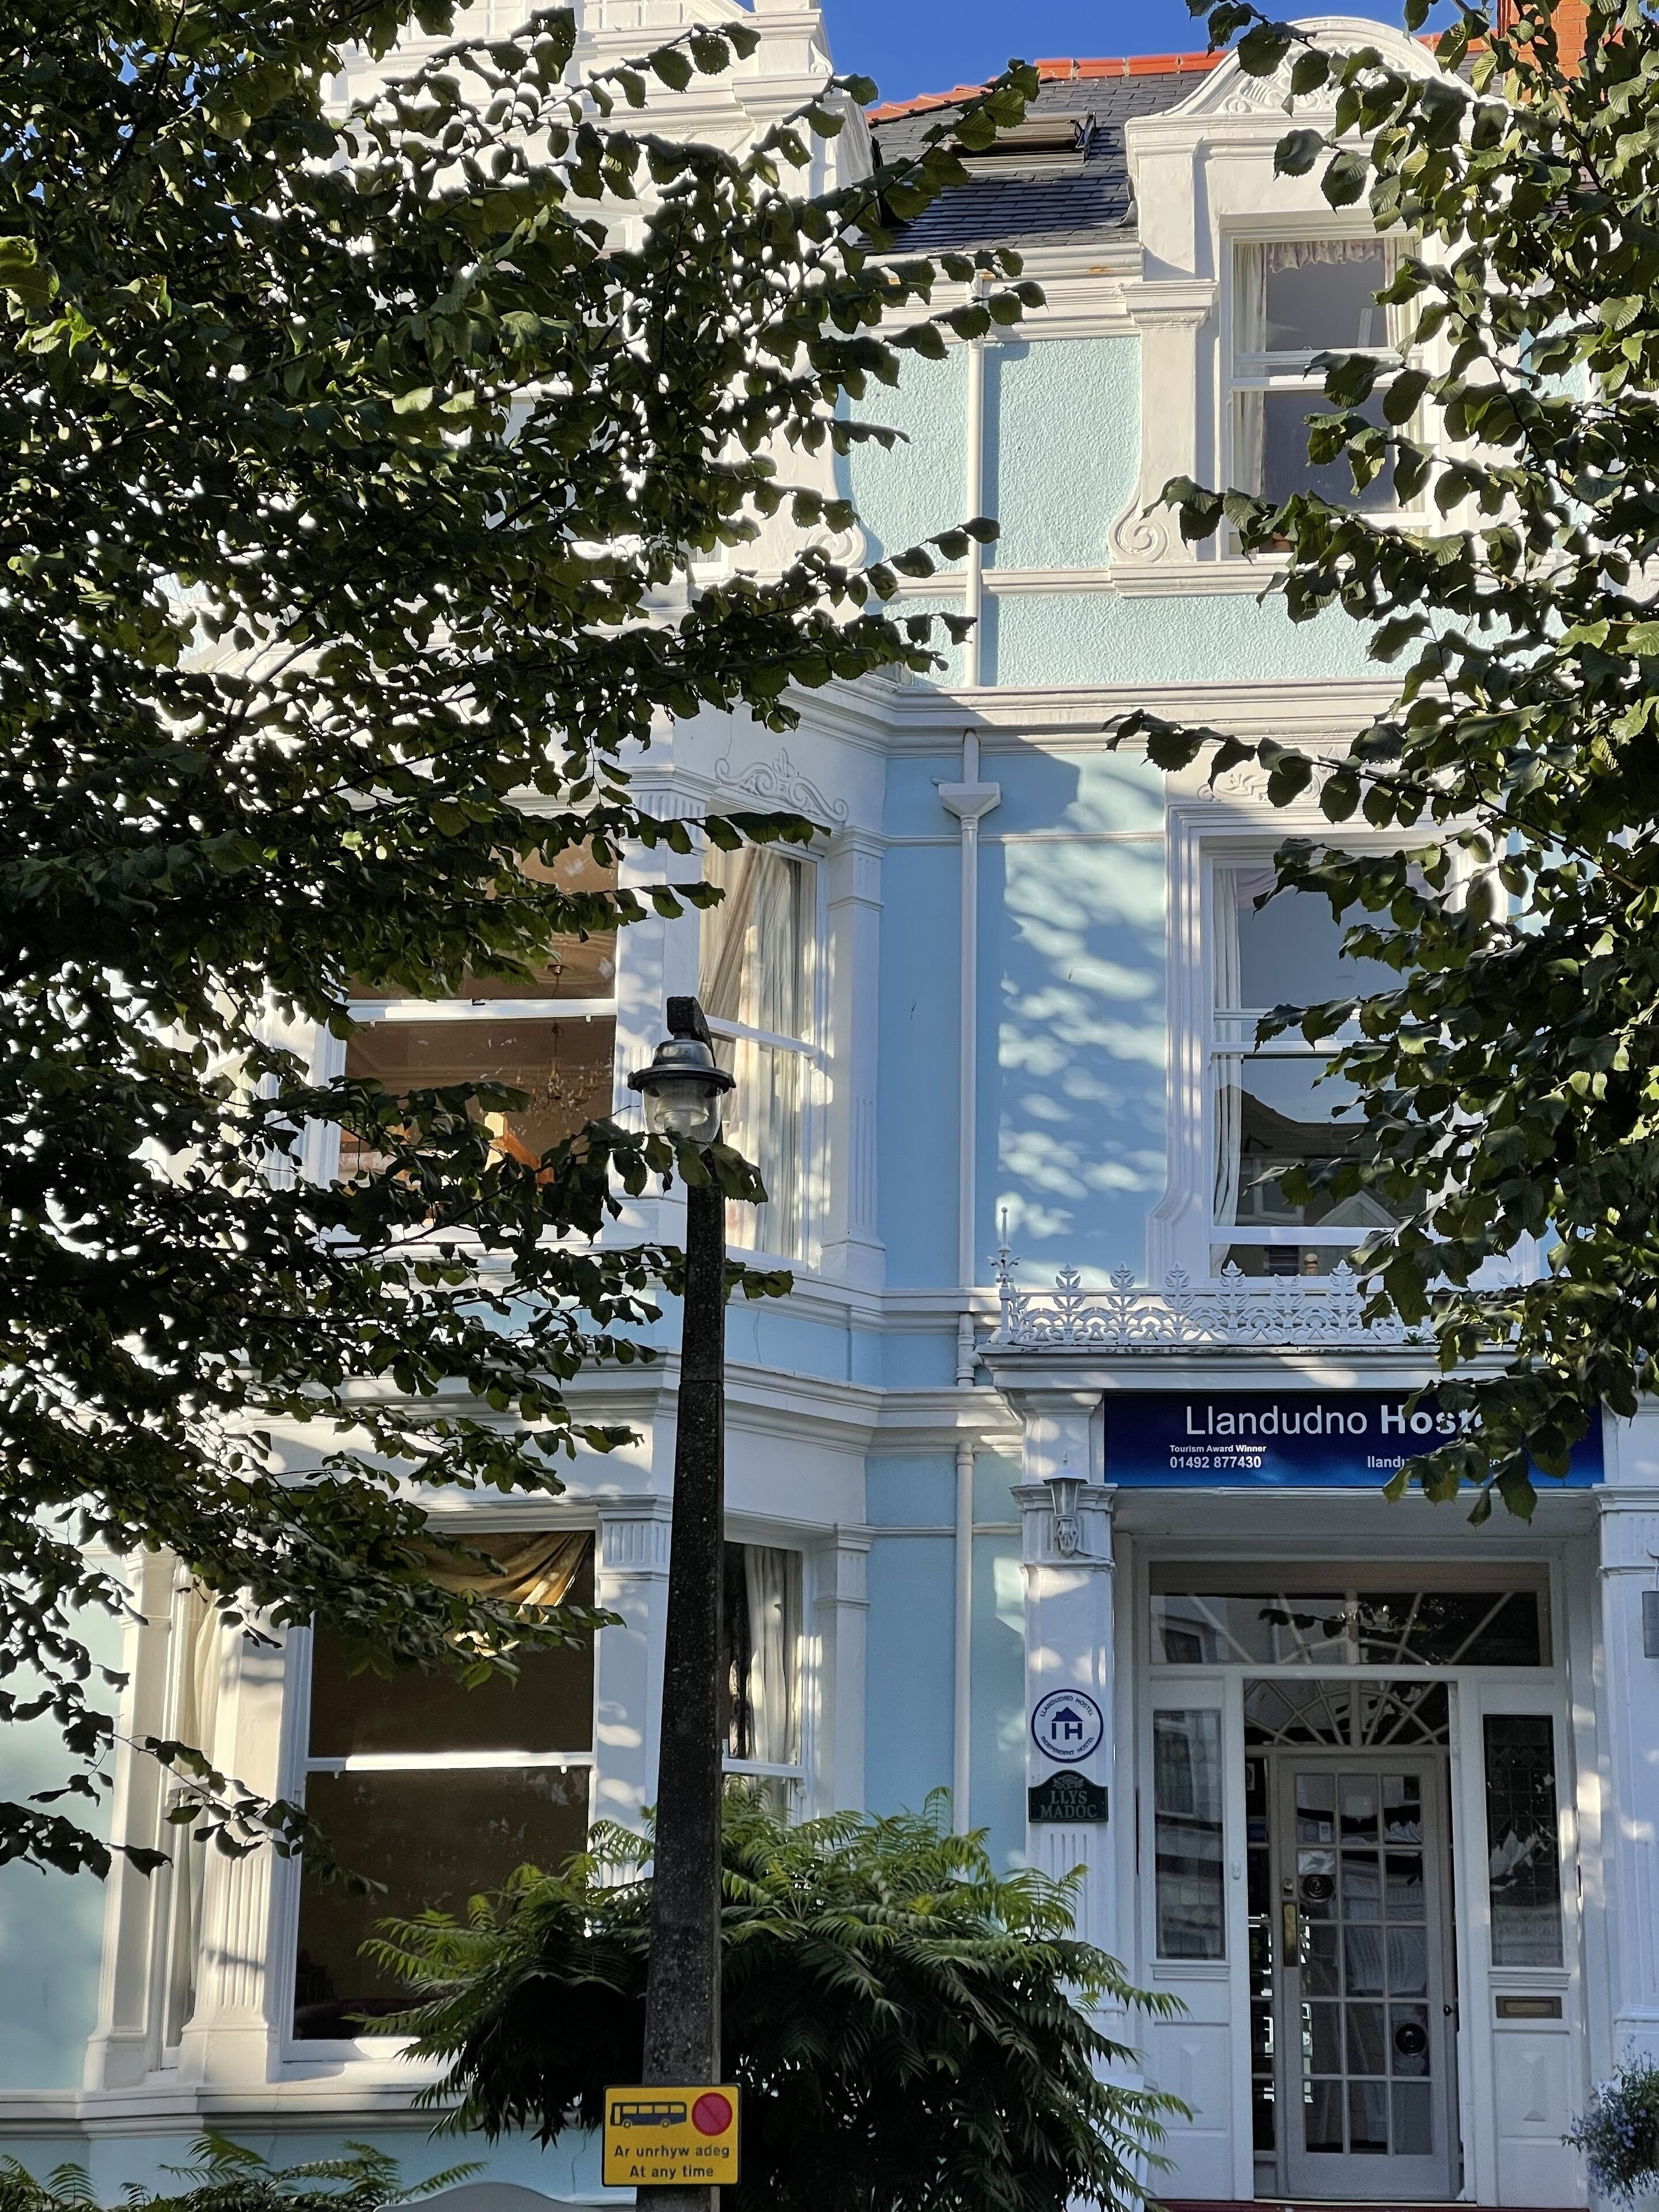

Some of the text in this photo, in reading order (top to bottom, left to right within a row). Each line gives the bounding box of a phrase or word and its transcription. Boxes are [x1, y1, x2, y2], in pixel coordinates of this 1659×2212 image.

[1187, 1405, 1368, 1435] Llandudno
[1169, 1445, 1205, 1453] Tourism
[1235, 1444, 1267, 1452] Winner
[1169, 1456, 1262, 1468] 01492 877430
[1075, 1698, 1093, 1716] HOSTEL
[1041, 1736, 1094, 1756] INDEPENDENT HOSTEL
[1051, 1790, 1088, 1805] LLYS
[1040, 1805, 1097, 1819] MADOC
[614, 2145, 730, 2159] Ar unrhyw adeg
[630, 2165, 714, 2180] At any time
